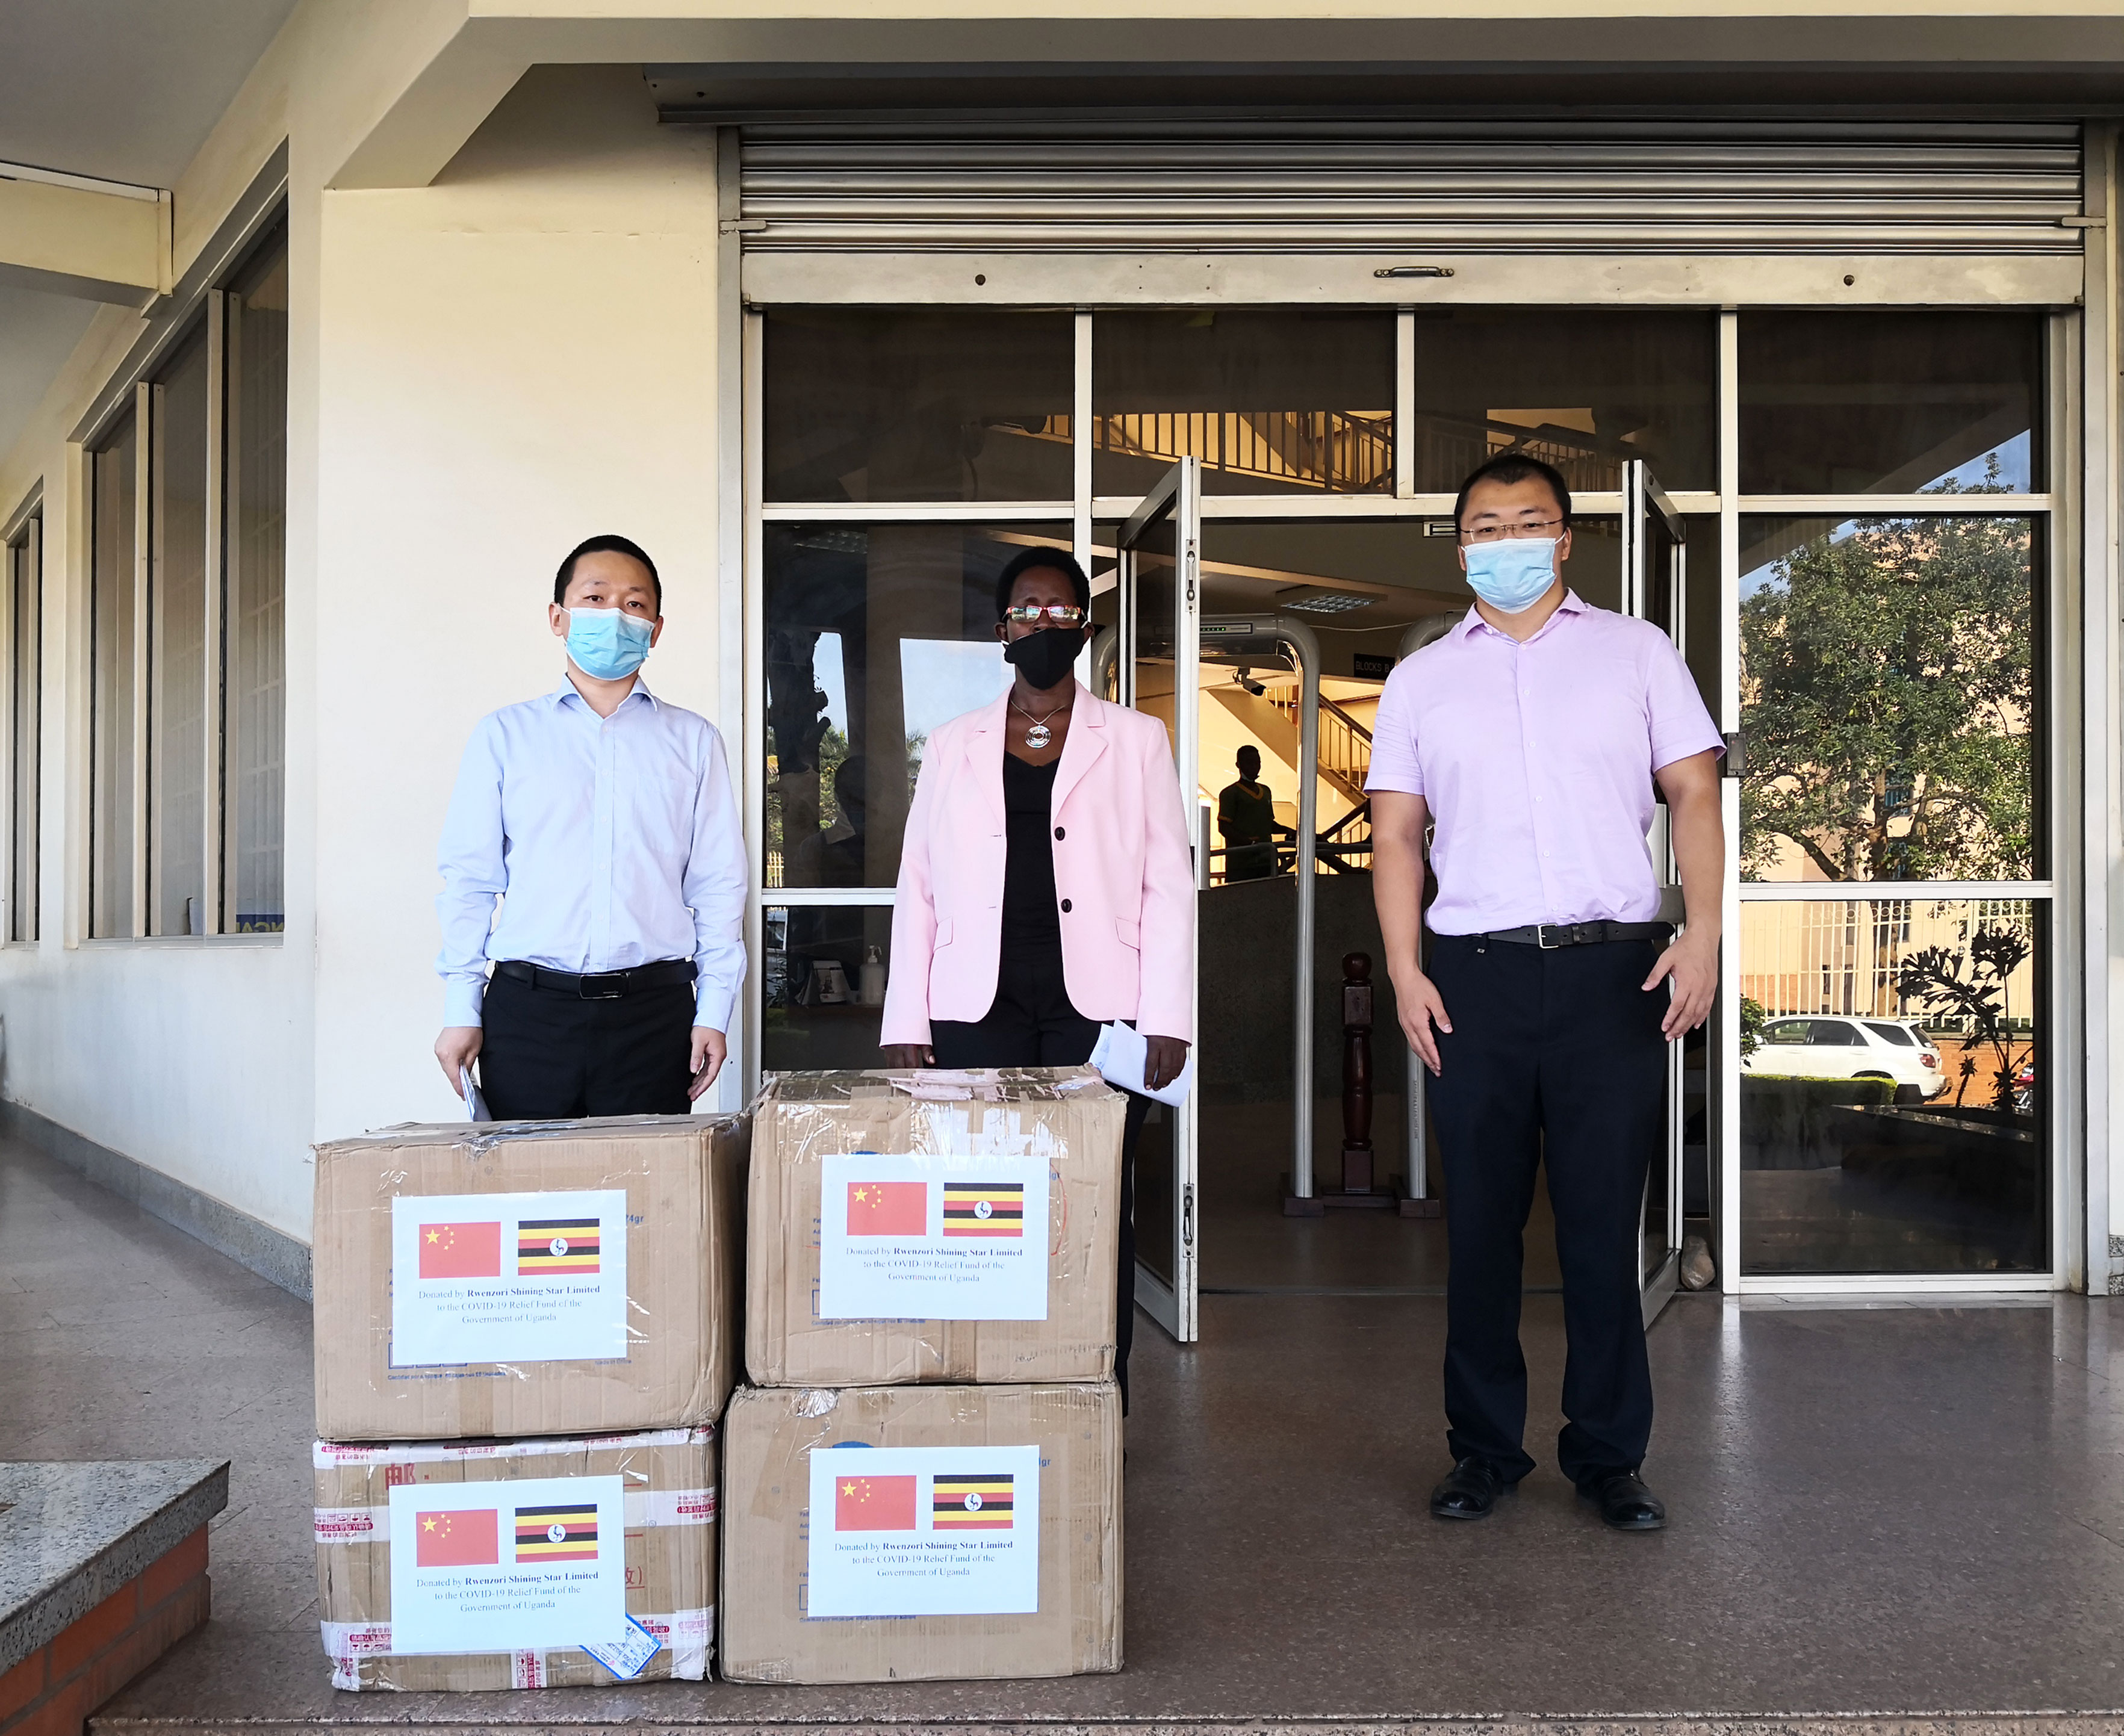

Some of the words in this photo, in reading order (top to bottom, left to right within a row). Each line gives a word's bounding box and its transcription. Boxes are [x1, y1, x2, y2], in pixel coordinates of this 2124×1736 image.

[1355, 661, 1382, 672] BLOCKS
[846, 1247, 879, 1255] Donated
[881, 1247, 891, 1257] by
[893, 1247, 933, 1256] Rwenzori
[935, 1248, 967, 1258] Shining
[990, 1248, 1023, 1257] Limited
[874, 1259, 886, 1268] the
[887, 1259, 932, 1268] COVID-19
[934, 1260, 957, 1269] Relief
[960, 1260, 980, 1269] Fund
[982, 1261, 991, 1269] of
[992, 1261, 1005, 1269] the
[888, 1273, 937, 1282] Government
[949, 1274, 980, 1284] Uganda
[418, 1289, 453, 1299] Donated
[455, 1289, 465, 1300] by
[467, 1288, 508, 1298] Rwenzori
[510, 1287, 544, 1297] Shining
[545, 1286, 564, 1295] Star
[567, 1285, 600, 1294] Limited
[447, 1303, 459, 1311] the
[461, 1301, 507, 1310] COVID-19
[509, 1300, 535, 1309] Relief
[536, 1300, 556, 1308] Fund
[570, 1299, 582, 1307] the
[462, 1315, 512, 1324] Government
[526, 1313, 557, 1324] Uganda
[834, 1542, 868, 1551] Donated
[870, 1542, 880, 1553] by
[883, 1542, 923, 1551] Rwenzori
[925, 1541, 958, 1551] Shining
[960, 1541, 978, 1549] Star
[980, 1540, 1013, 1549] Limited
[862, 1555, 875, 1564] the
[877, 1555, 922, 1564] COVID-19
[924, 1554, 949, 1564] Relief
[950, 1554, 970, 1563] Fund
[972, 1554, 981, 1563] of
[983, 1554, 995, 1563] the
[877, 1568, 927, 1577] Government
[928, 1567, 937, 1576] of
[939, 1567, 970, 1578] Uganda
[417, 1578, 450, 1587] Donated
[452, 1577, 462, 1589] by
[465, 1575, 506, 1586] Rwenzori
[508, 1574, 542, 1584] Shining
[544, 1573, 563, 1582] Star
[565, 1570, 598, 1581] Limited
[434, 1592, 443, 1601] to
[445, 1591, 458, 1600] the
[459, 1589, 505, 1599] COVID-19
[508, 1587, 533, 1597] Relief
[534, 1586, 555, 1596] Fund
[557, 1586, 566, 1595] of
[568, 1585, 581, 1594] the
[460, 1602, 511, 1613] Government
[512, 1601, 523, 1610] of
[524, 1599, 556, 1611] Uganda
